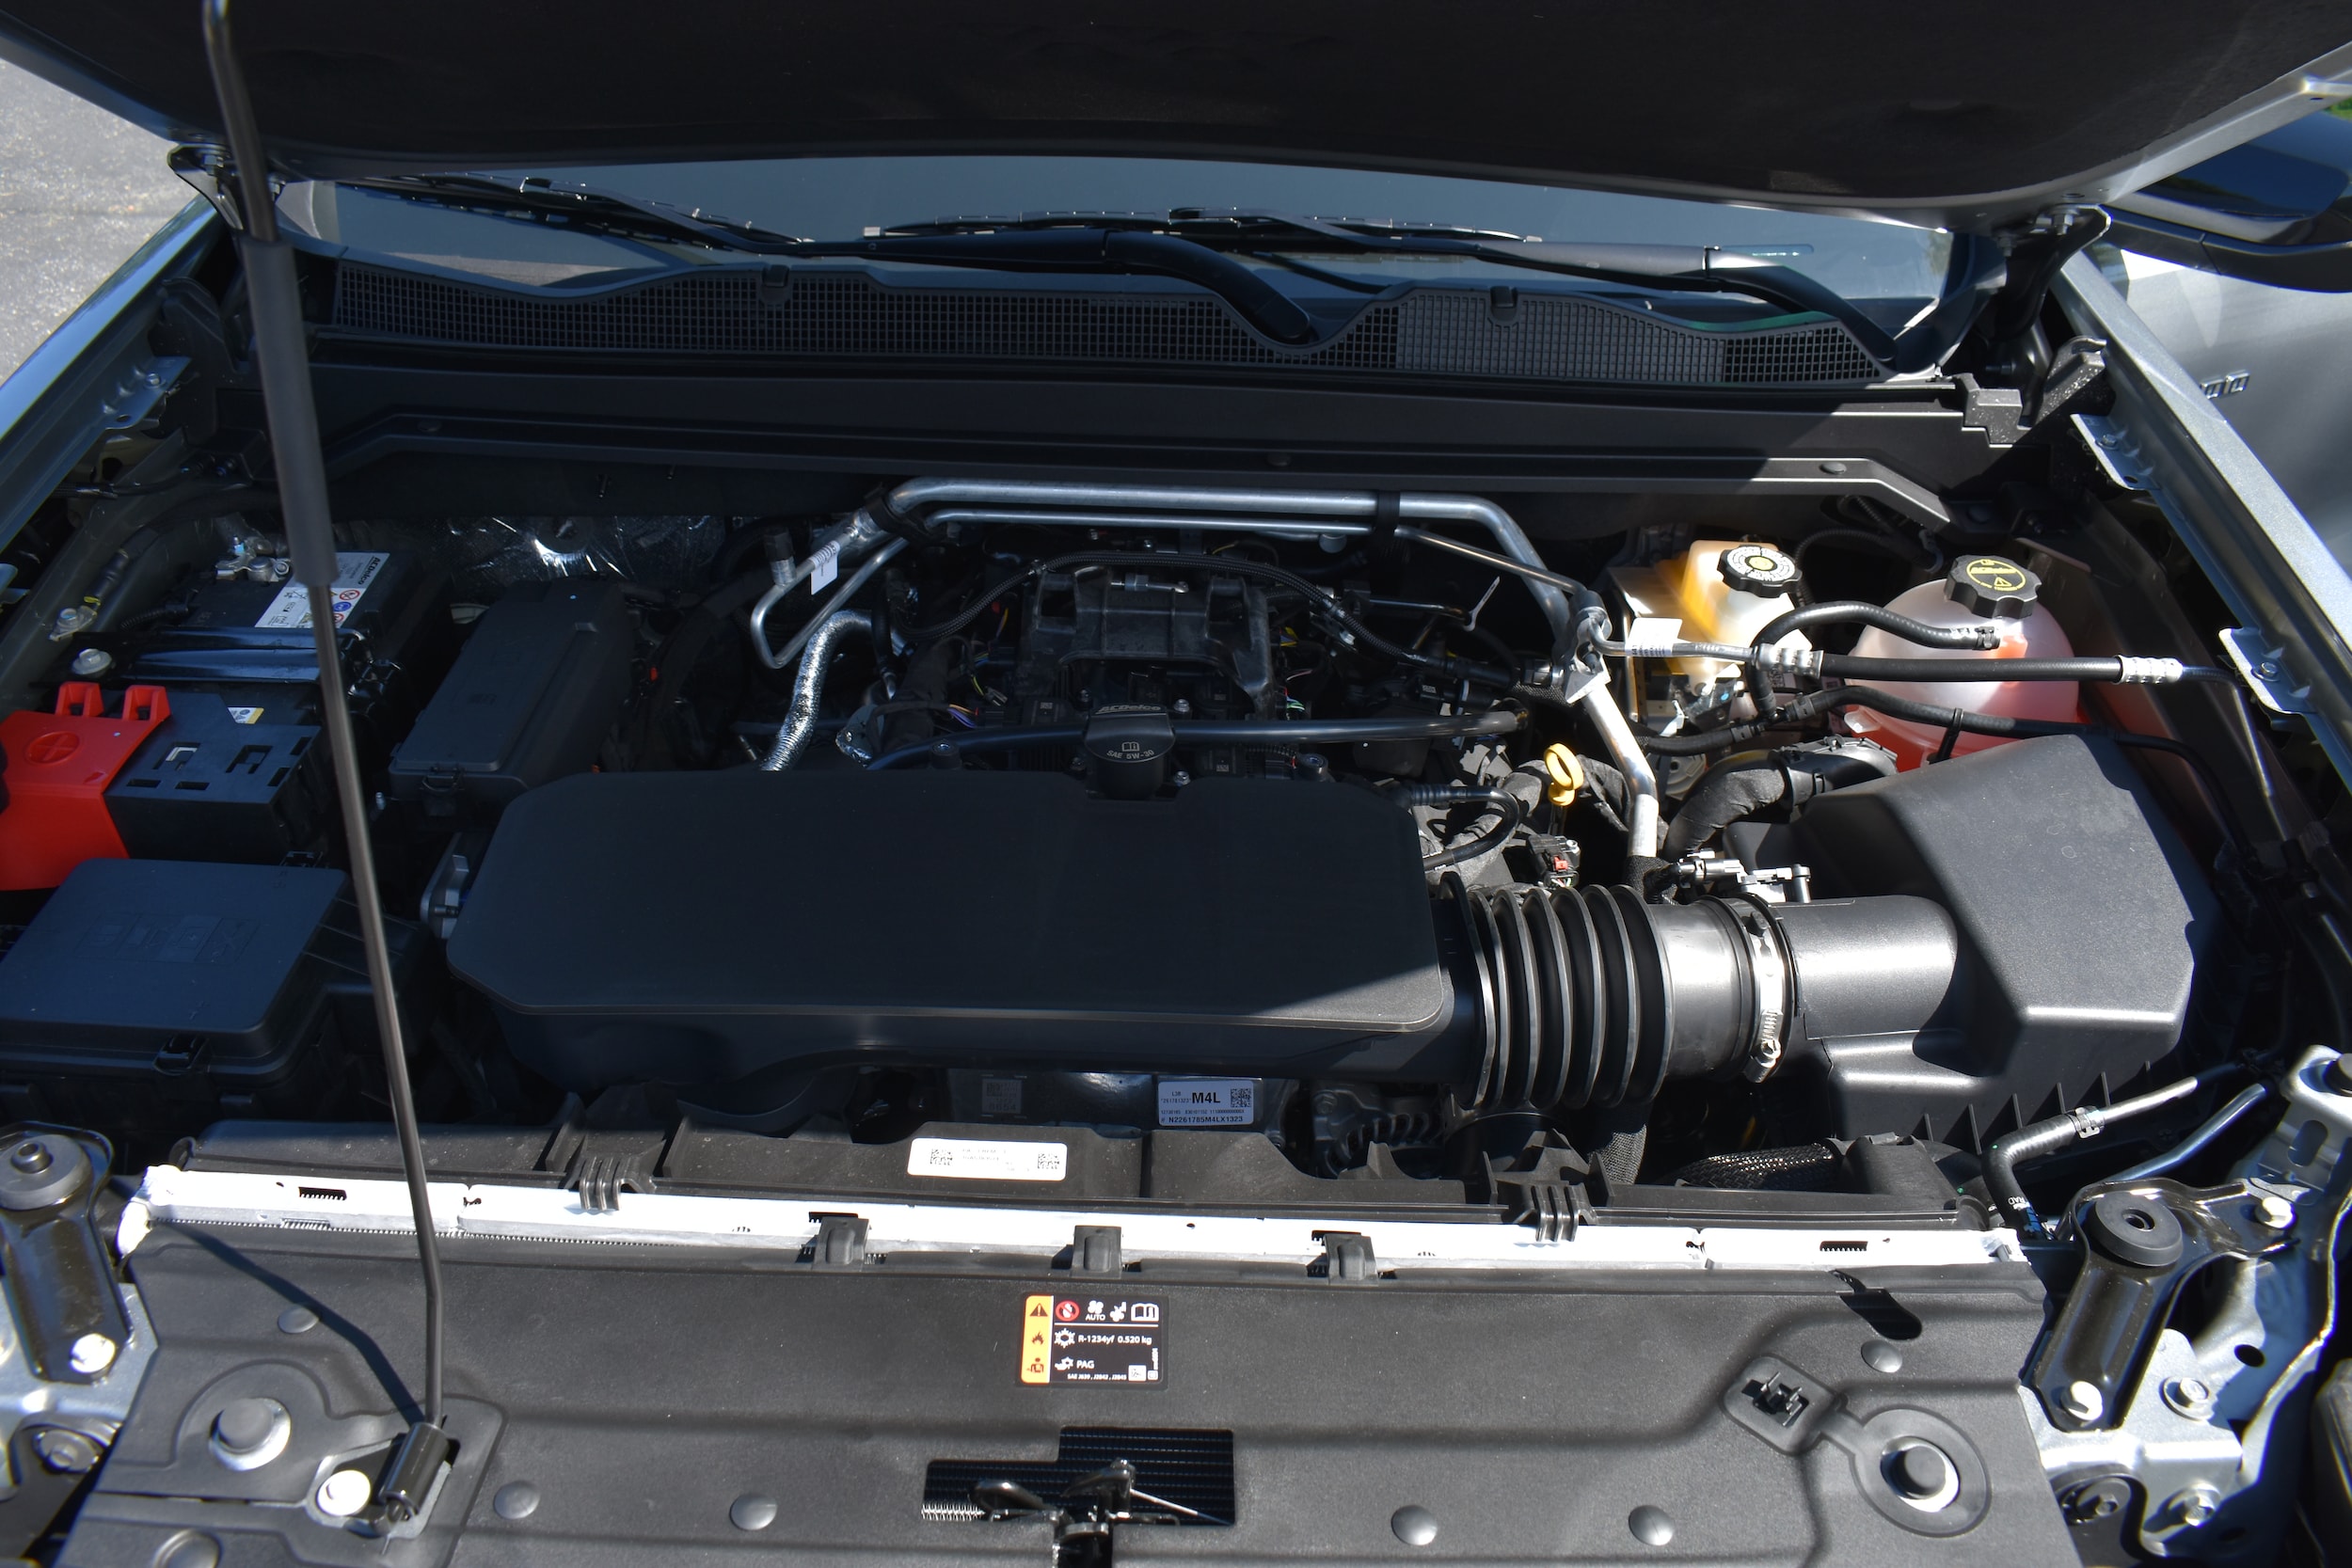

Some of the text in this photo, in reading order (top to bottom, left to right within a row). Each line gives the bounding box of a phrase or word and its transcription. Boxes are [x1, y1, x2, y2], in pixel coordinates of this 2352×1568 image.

[1097, 705, 1161, 713] ACDelco
[1106, 750, 1154, 759] SAE 5W-30
[1192, 1092, 1220, 1103] M4L
[1078, 1336, 1152, 1345] R-1234yf 0.520 kg
[1076, 1360, 1095, 1369] PAG
